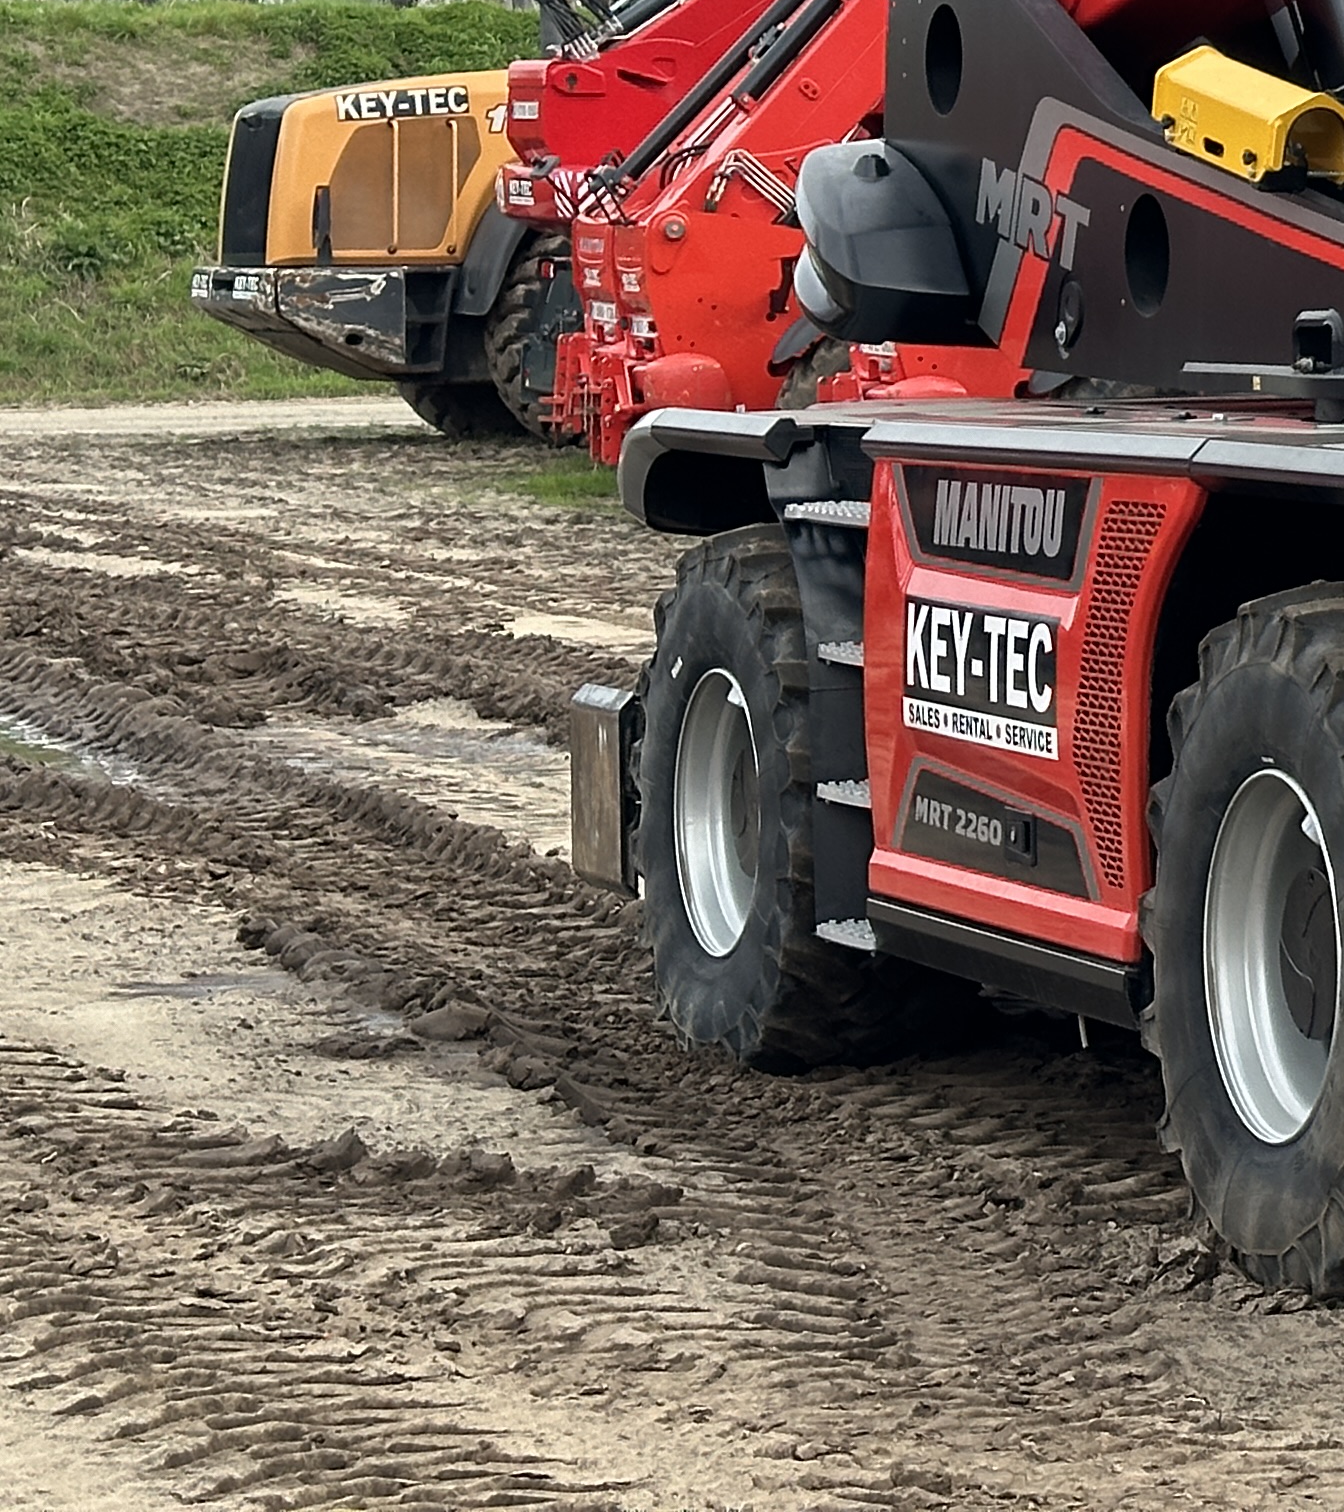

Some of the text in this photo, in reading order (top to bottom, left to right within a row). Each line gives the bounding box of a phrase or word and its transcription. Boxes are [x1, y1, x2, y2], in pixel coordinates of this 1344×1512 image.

[336, 87, 469, 120] KEY-TEC
[975, 157, 1091, 272] MRT
[933, 479, 1066, 558] MANITOU
[907, 602, 1053, 713] KEY-TEC
[908, 702, 1053, 754] SALES RENTAL SERVICE
[915, 795, 1003, 847] MRT 2260
